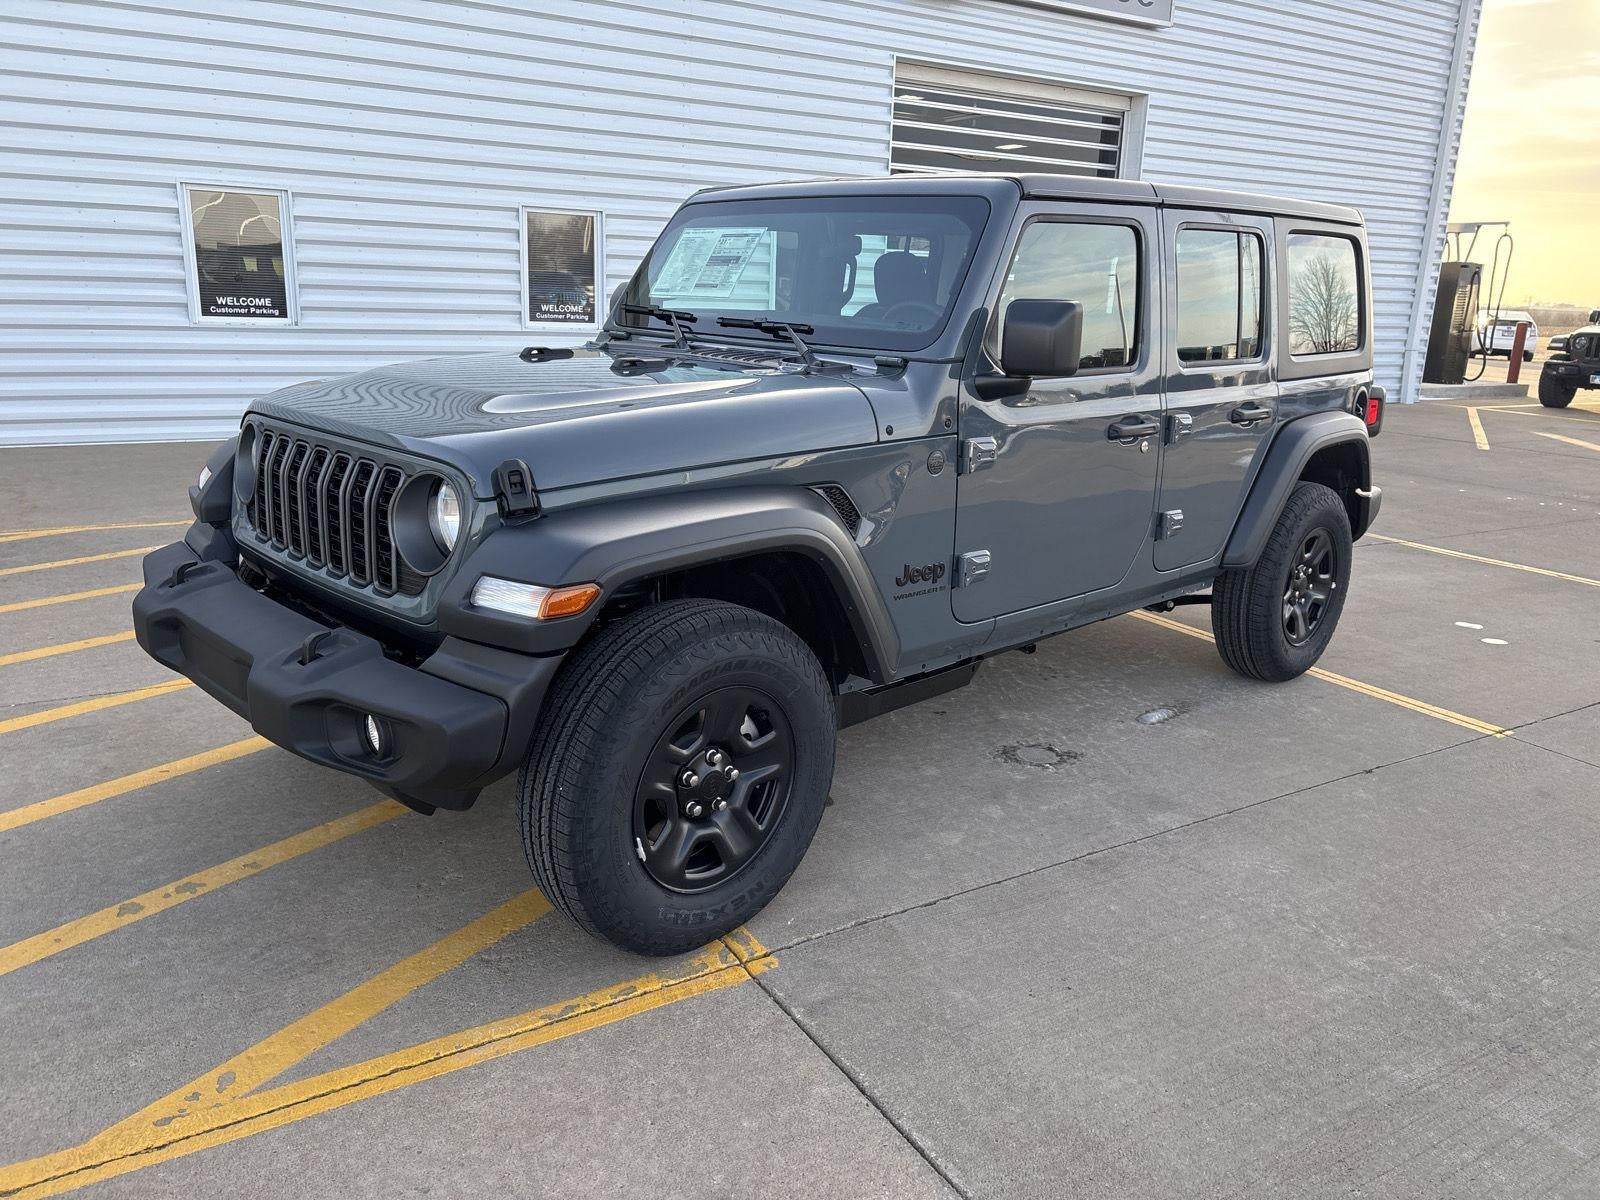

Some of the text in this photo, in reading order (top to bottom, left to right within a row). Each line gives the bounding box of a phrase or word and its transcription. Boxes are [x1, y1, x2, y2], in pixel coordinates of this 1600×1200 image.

[216, 296, 272, 306] WELCOME
[210, 306, 279, 316] Customer Parking
[541, 304, 584, 312] WELCOME
[567, 313, 589, 321] Parking
[895, 562, 945, 587] Jeep
[893, 587, 938, 601] WRANGLER
